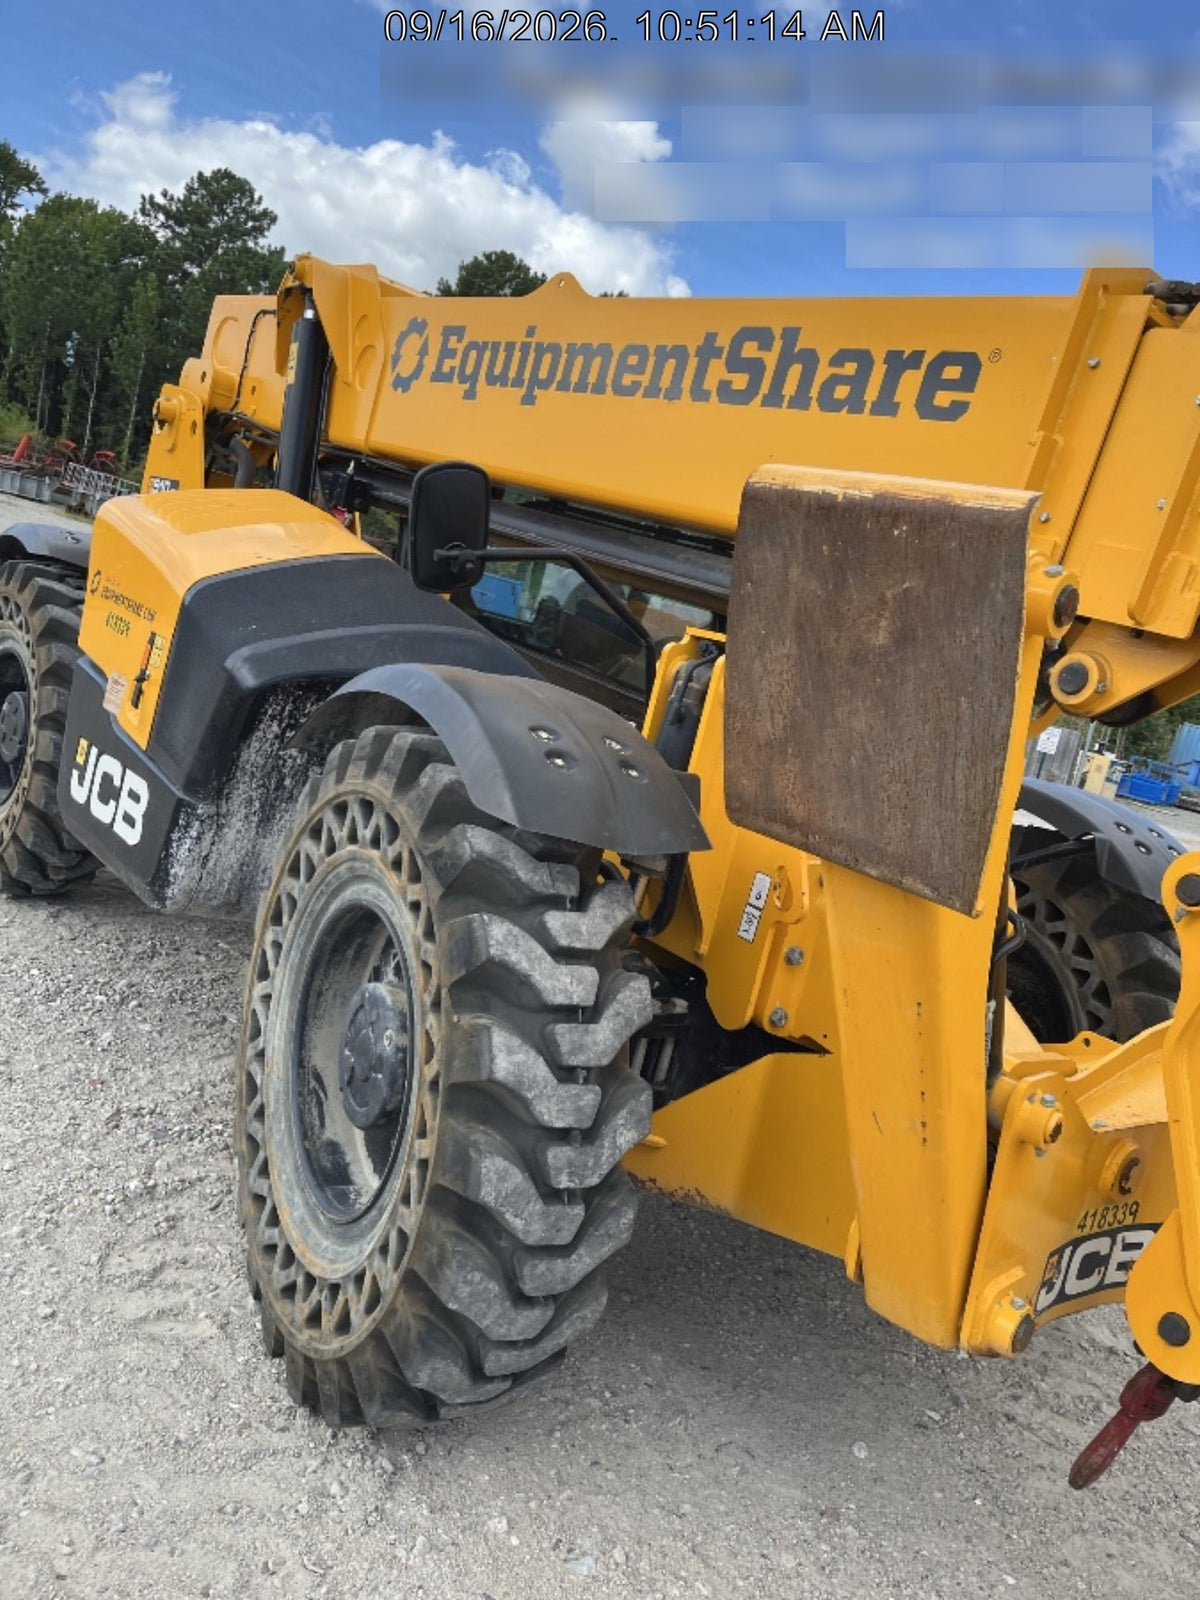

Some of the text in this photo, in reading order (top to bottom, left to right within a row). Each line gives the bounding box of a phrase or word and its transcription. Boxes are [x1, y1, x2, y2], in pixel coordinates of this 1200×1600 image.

[430, 325, 982, 422] EquipmentShare
[70, 745, 149, 846] JCB
[1077, 1200, 1139, 1232] 418339
[1036, 1229, 1155, 1311] JCB
